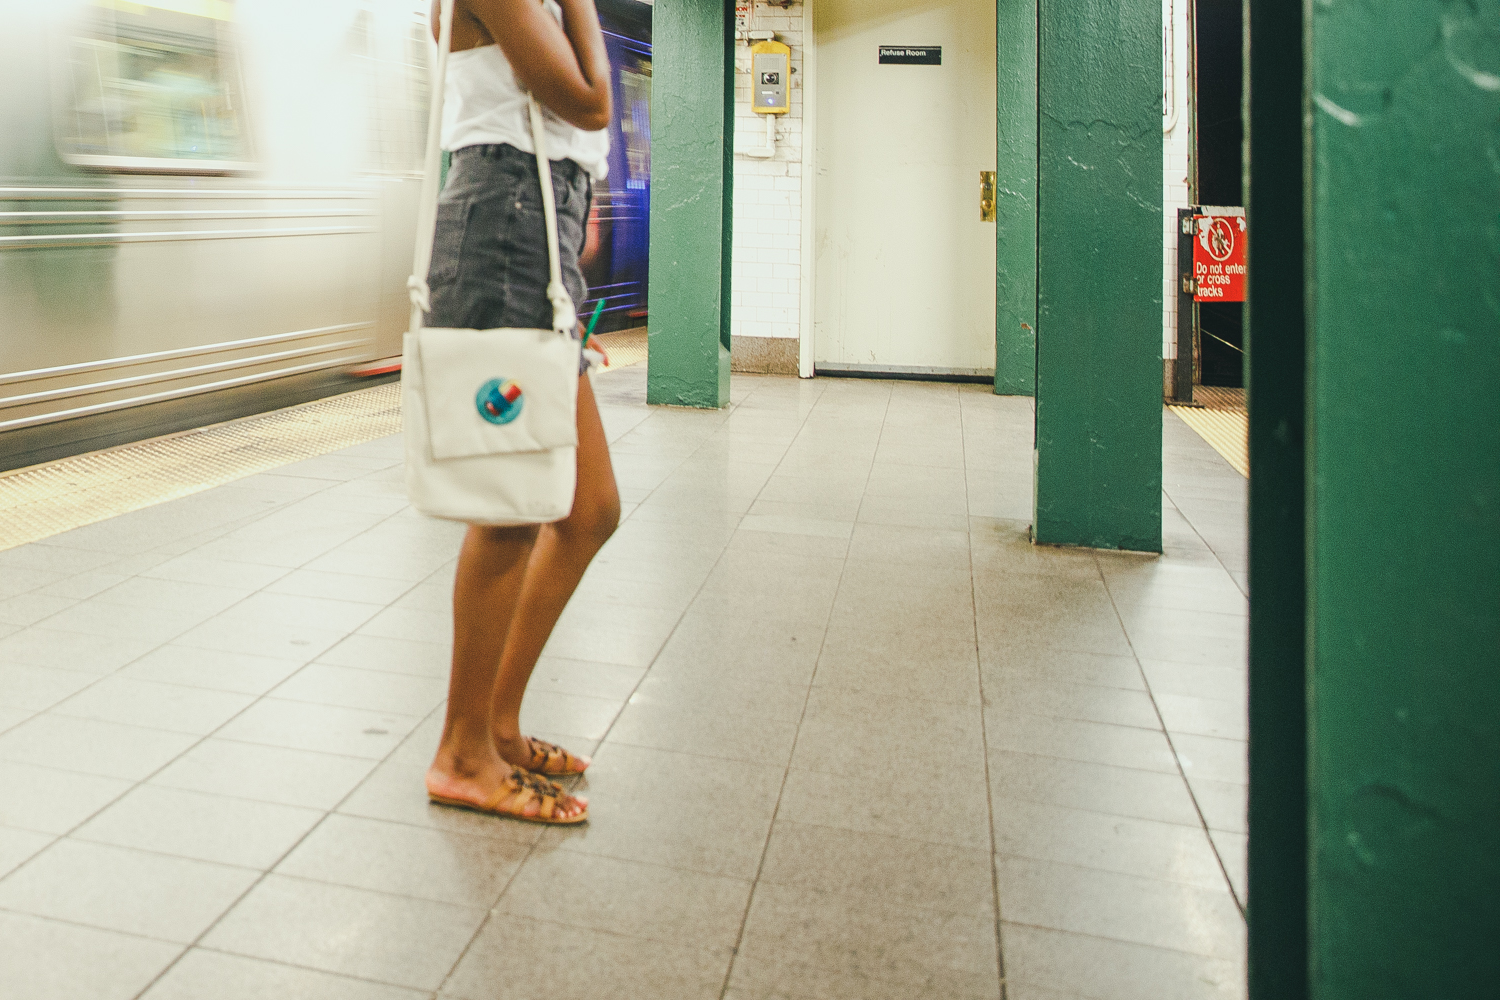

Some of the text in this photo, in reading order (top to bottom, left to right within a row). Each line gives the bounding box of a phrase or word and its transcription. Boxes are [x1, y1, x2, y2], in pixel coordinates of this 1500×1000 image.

[1196, 261, 1247, 275] Do not enter
[1196, 274, 1231, 285] or cross
[1197, 285, 1224, 298] tracks
